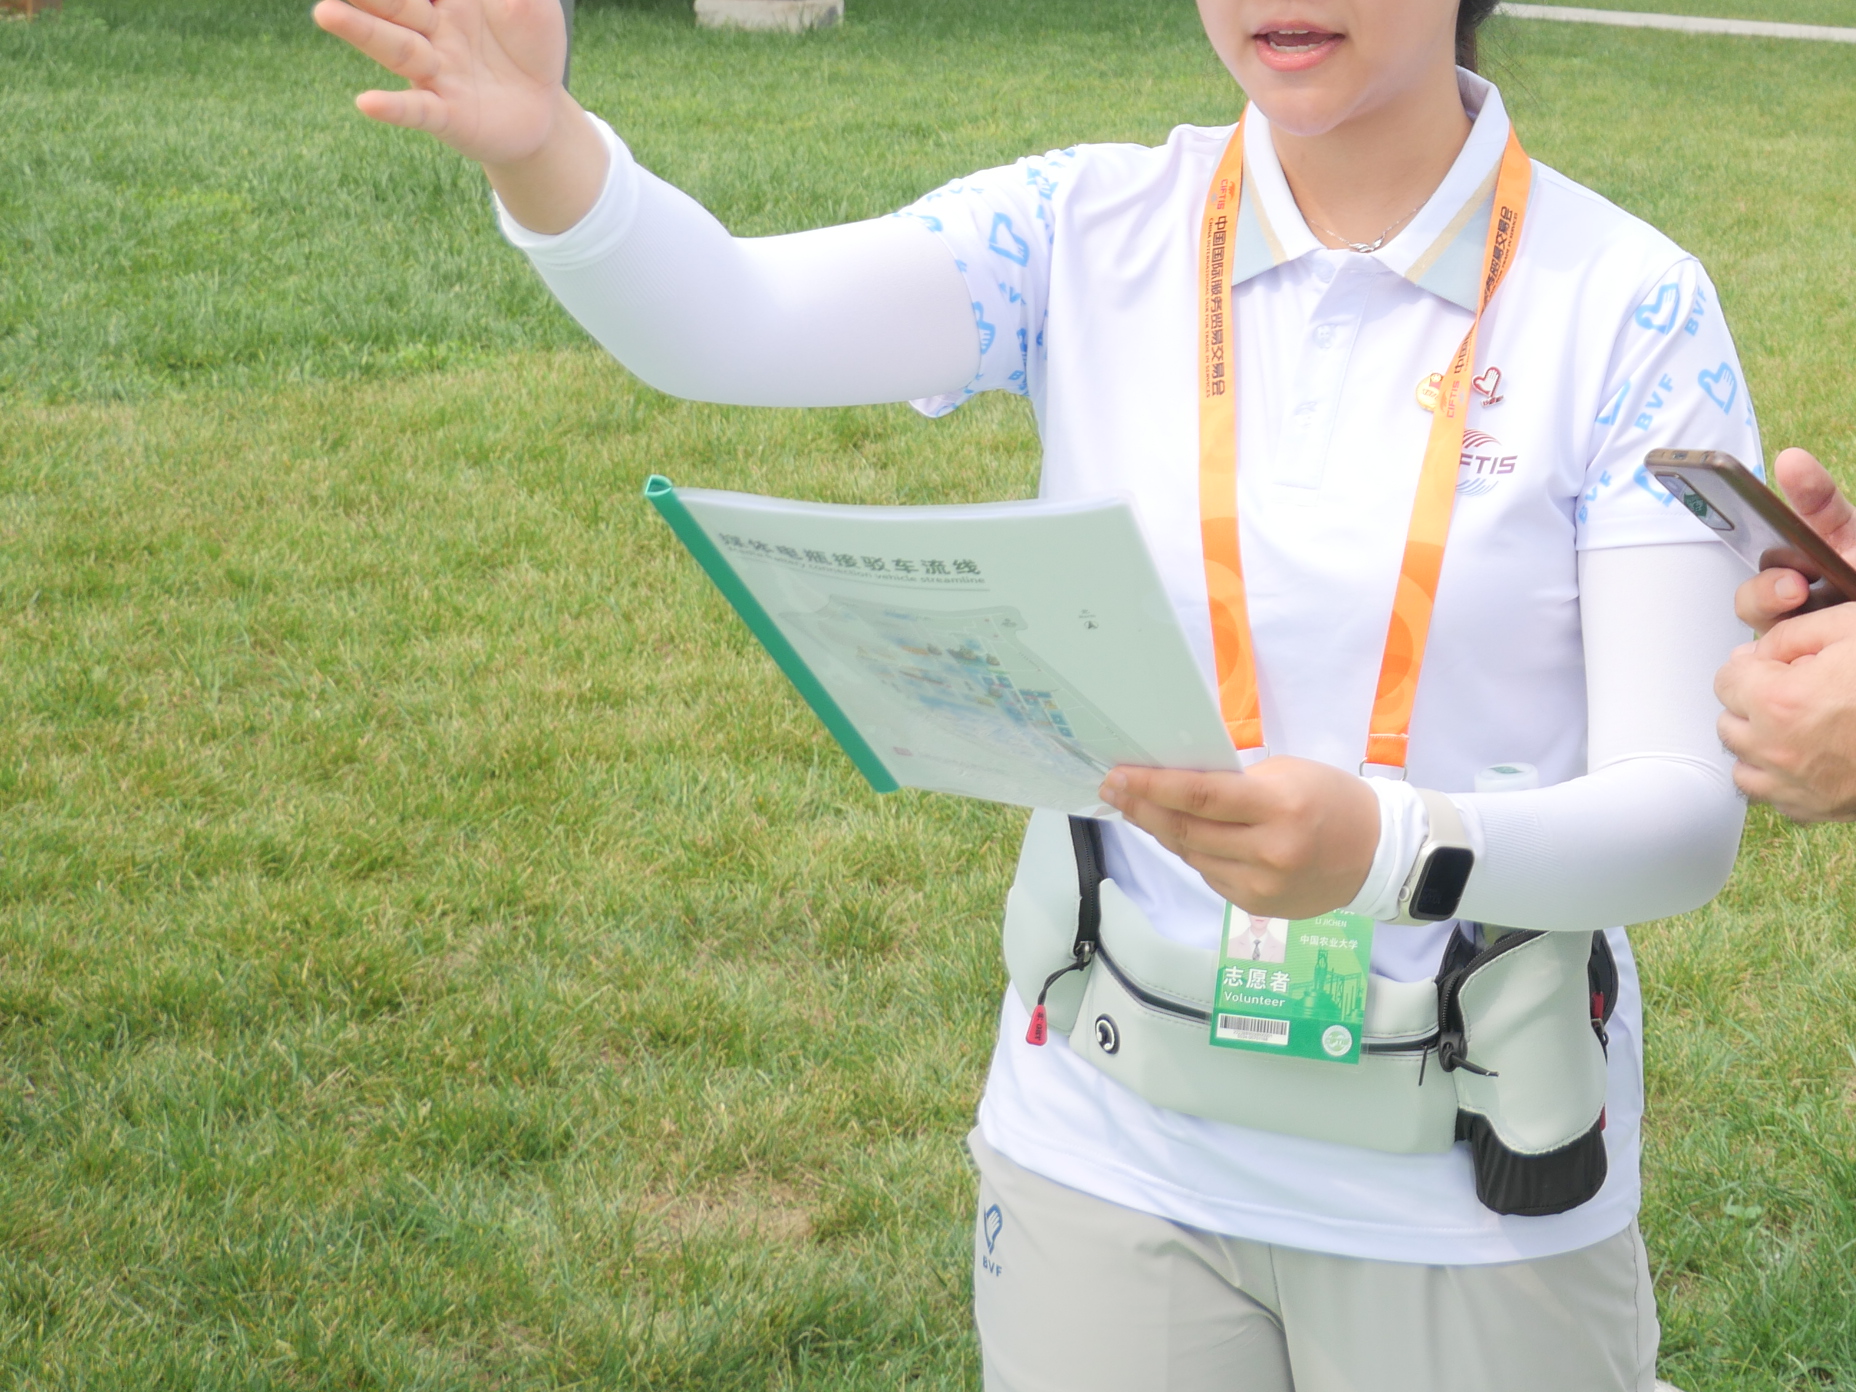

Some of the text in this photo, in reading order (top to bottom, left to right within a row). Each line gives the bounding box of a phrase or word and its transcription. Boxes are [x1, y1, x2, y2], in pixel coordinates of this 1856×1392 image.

[1216, 178, 1229, 210] CIFTIS
[1210, 215, 1228, 396] 中国国际服务贸易交易会
[1683, 285, 1708, 337] BVF
[1446, 380, 1460, 418] CIFTIS
[1633, 373, 1675, 431] BVF
[1459, 452, 1518, 475] FTIS
[1578, 469, 1613, 525] BVF
[1300, 934, 1359, 950] 中国农业大学
[1223, 965, 1291, 993] 志愿者
[1223, 990, 1286, 1007] Volunteer
[982, 1254, 1003, 1277] BVF
